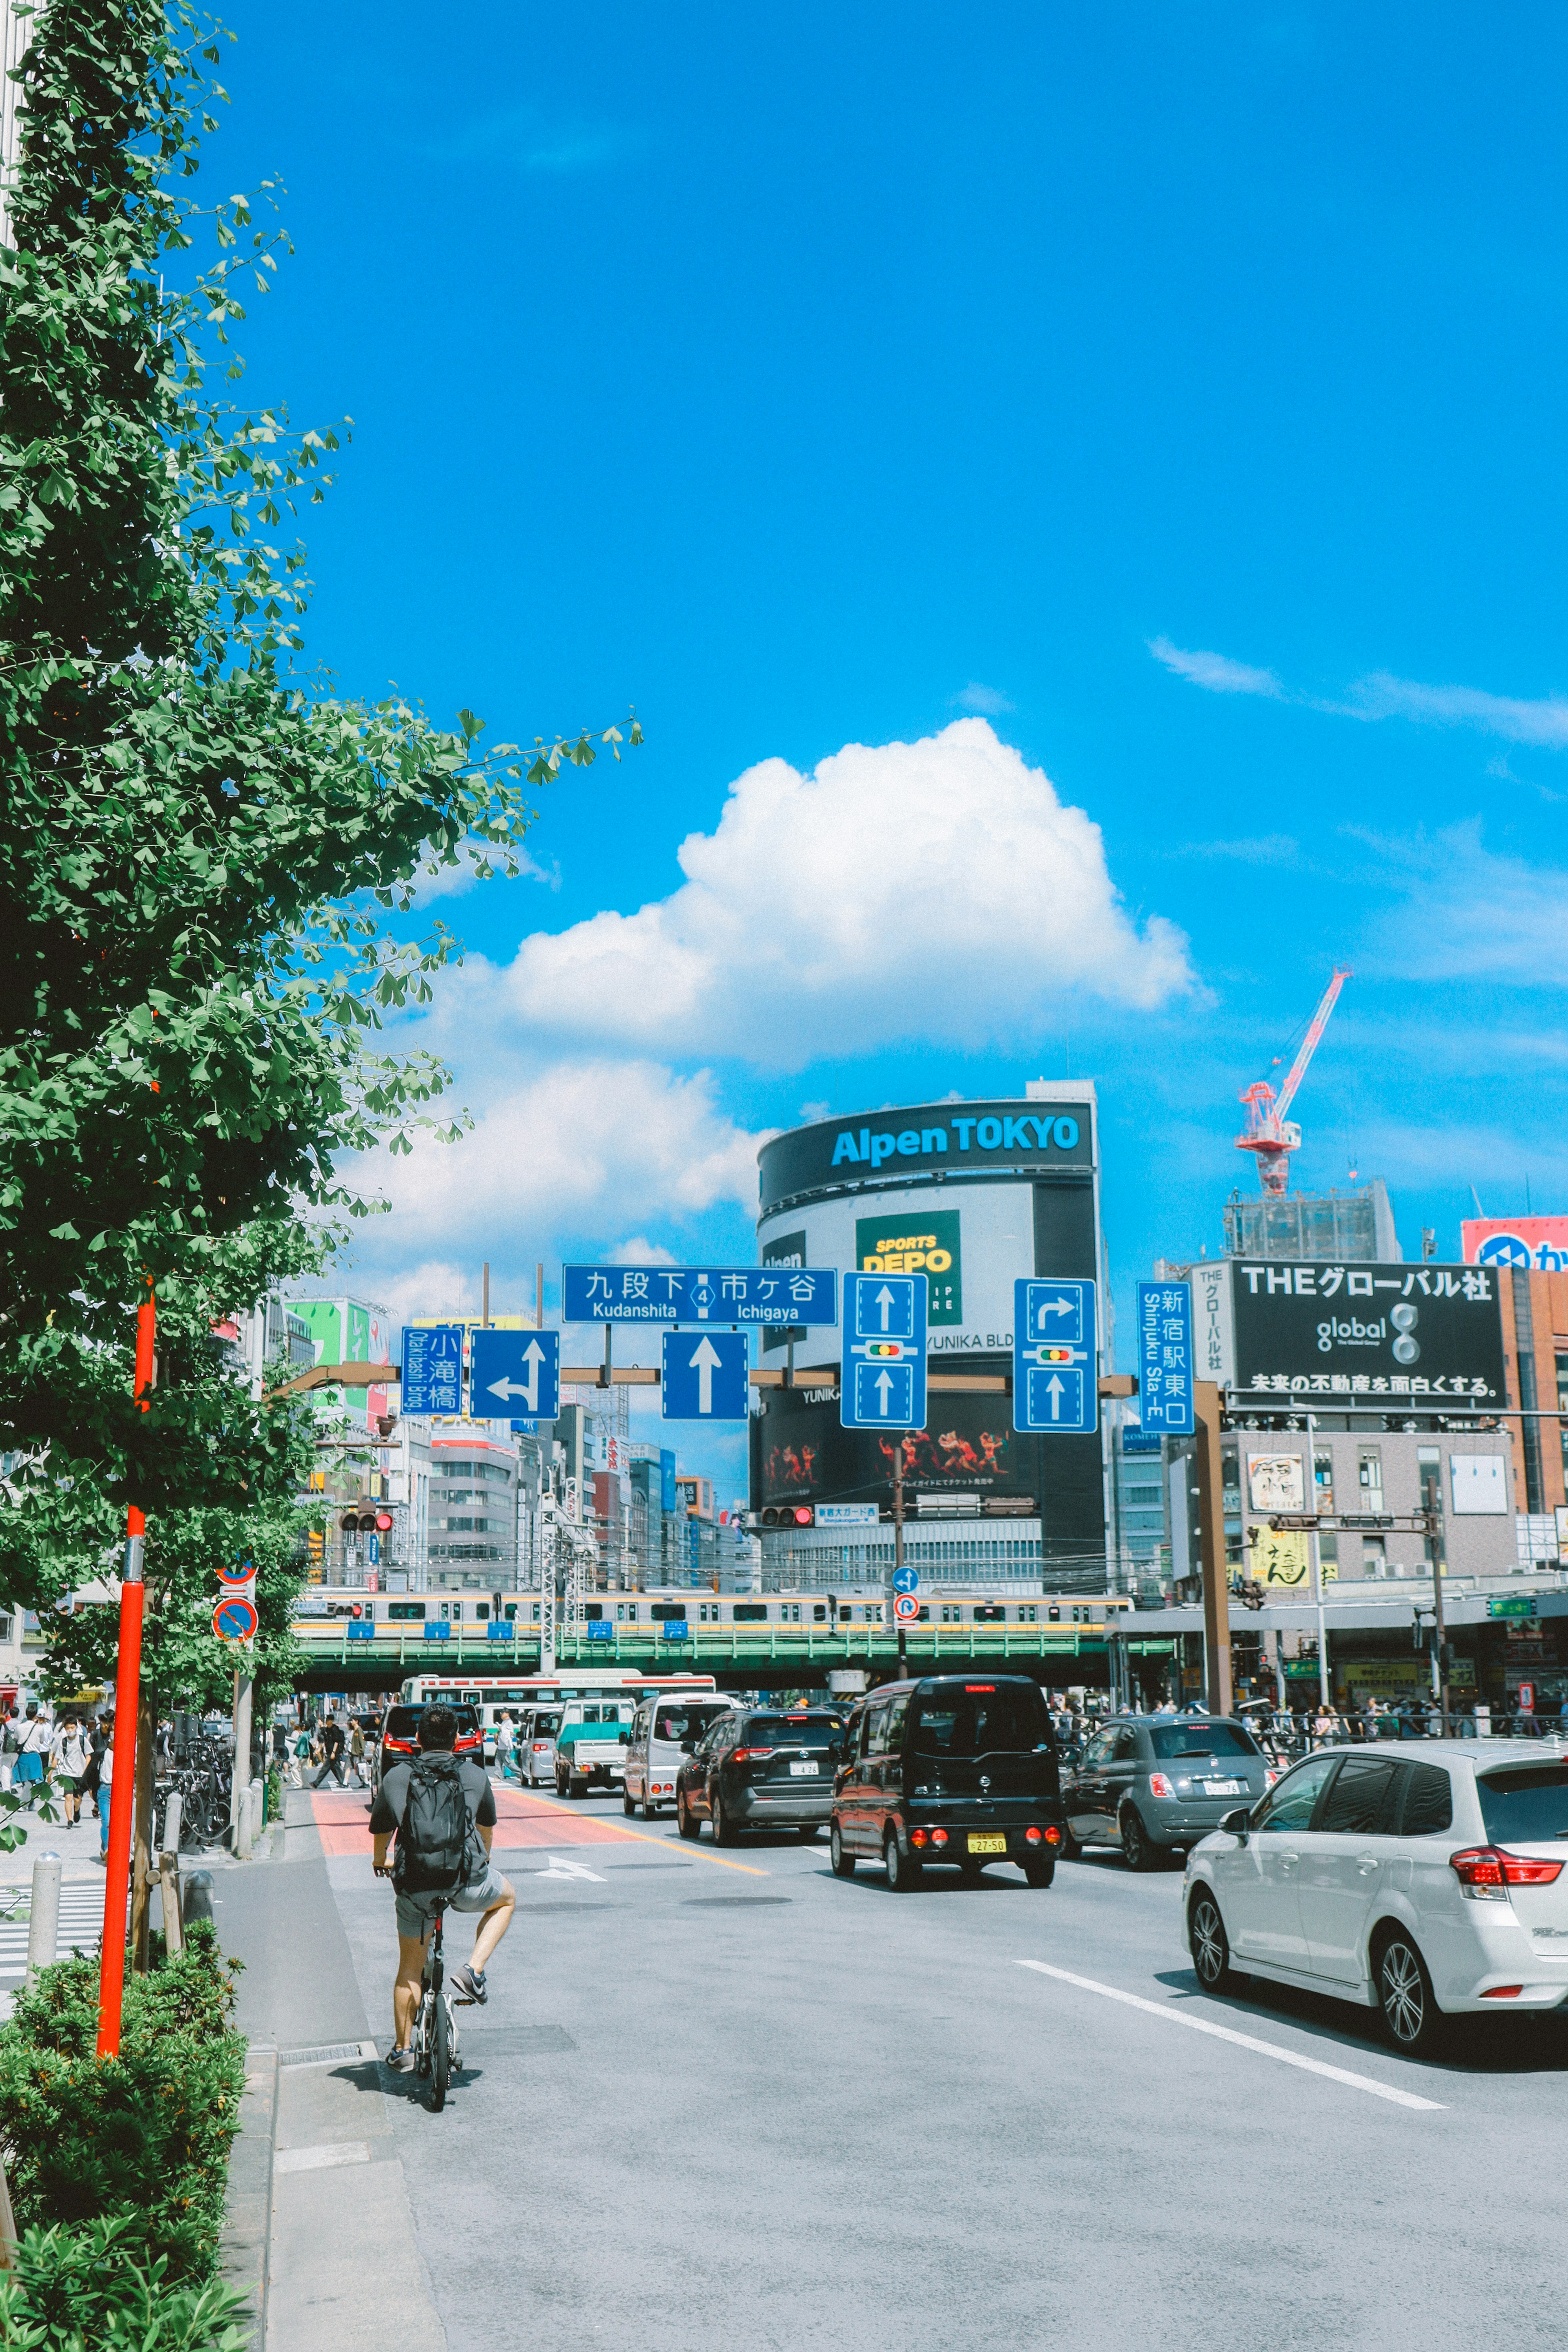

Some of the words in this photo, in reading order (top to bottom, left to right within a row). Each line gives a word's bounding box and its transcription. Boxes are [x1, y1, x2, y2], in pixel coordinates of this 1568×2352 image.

[831, 1128, 948, 1168] Alpen
[951, 1116, 1079, 1151] TOKYO
[876, 1235, 937, 1254] SPORTS
[863, 1249, 952, 1273] DEPO
[585, 1271, 685, 1300] 九段下
[698, 1289, 708, 1304] 4
[1241, 1267, 1493, 1301] THEグローバル社
[593, 1303, 677, 1318] Kudanshita
[737, 1305, 799, 1322] Ichigaya
[1142, 1293, 1160, 1360] Shinjuku
[1316, 1316, 1386, 1352] global
[408, 1332, 428, 1383] Otakibashi
[1161, 1290, 1186, 1424] 新宿駅東口
[428, 1334, 457, 1409] 小滝橋
[403, 1386, 427, 1411] Brdg.
[1251, 1374, 1497, 1398] 未来の不動産を面白くする。
[977, 1841, 1003, 1851] 27-50
